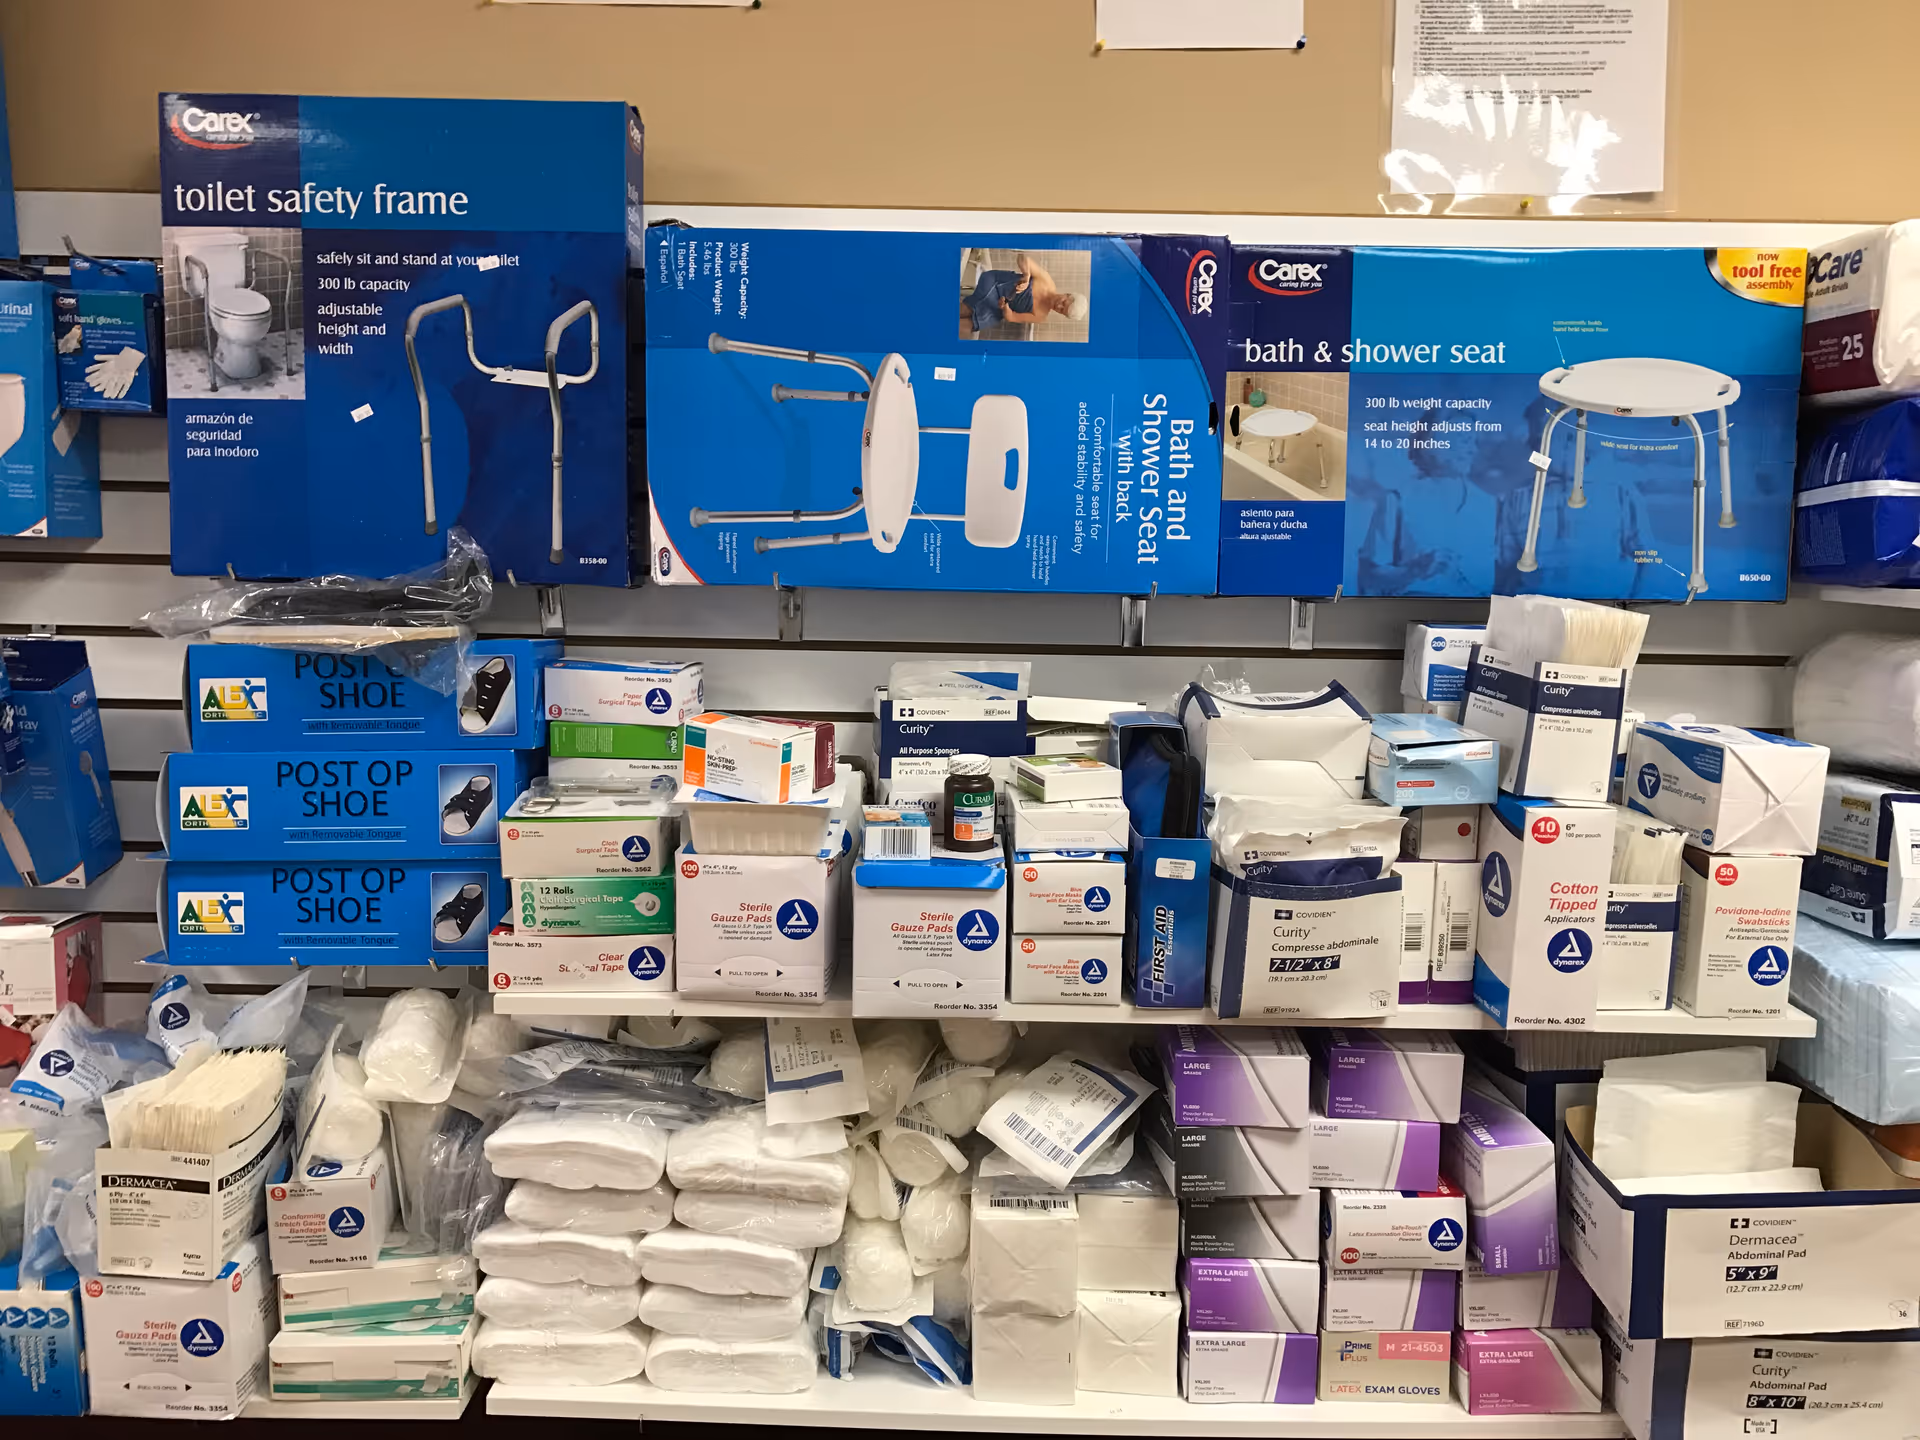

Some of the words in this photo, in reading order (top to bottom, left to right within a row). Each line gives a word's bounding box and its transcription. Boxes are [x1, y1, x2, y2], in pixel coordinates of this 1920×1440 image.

[182, 108, 254, 132] Carex
[175, 183, 256, 213] toilet
[268, 184, 363, 219] safety
[373, 184, 468, 215] frame
[730, 242, 738, 258] 300
[689, 241, 697, 280] Includes:
[715, 242, 723, 277] Product
[739, 242, 749, 275] Weight
[1757, 253, 1779, 261] now
[659, 249, 668, 283] Español
[730, 261, 738, 273] lbs
[1259, 259, 1322, 281] Carex
[1732, 265, 1765, 278] tool
[1769, 265, 1801, 278] free
[318, 278, 341, 290] 300
[345, 278, 356, 290] lb
[359, 278, 410, 292] capacity
[1197, 259, 1217, 314] Carex
[1300, 280, 1309, 288] for
[1746, 280, 1794, 291] assembly
[713, 279, 723, 315] Weight:
[738, 278, 749, 319] Capacity:
[318, 302, 383, 318] adjustable
[59, 315, 72, 323] soft
[74, 315, 93, 324] hand
[96, 315, 122, 325] gloves
[318, 322, 359, 337] height
[363, 322, 386, 336] and
[318, 342, 353, 356] width
[1245, 338, 1304, 363] bath
[1314, 340, 1332, 363] &
[1341, 339, 1441, 363] shower
[1449, 342, 1506, 363] seat
[1842, 334, 1863, 360] 25
[1365, 398, 1386, 408] 300
[1389, 397, 1399, 408] lb
[1402, 398, 1443, 410] weight
[1445, 398, 1491, 410] capacity
[186, 412, 236, 425] armazón
[238, 412, 253, 425] de
[1078, 402, 1089, 440] added
[1364, 422, 1387, 431] seat
[1391, 421, 1429, 433] height
[1431, 421, 1471, 433] adjusts
[1475, 421, 1501, 431] from
[186, 428, 241, 443] seguridad
[1141, 394, 1168, 497] Shower
[1169, 419, 1194, 478] Bath
[1364, 439, 1378, 449] 14
[1381, 440, 1392, 449] to
[1396, 438, 1410, 449] 20
[1413, 438, 1450, 449] inches
[186, 446, 211, 458] para
[214, 445, 259, 458] inodoro
[1092, 417, 1105, 492] Comfortable
[1118, 435, 1134, 473] with
[1074, 444, 1088, 490] stability
[1075, 494, 1086, 516] and
[1091, 496, 1101, 520] seat
[1116, 481, 1133, 523] back
[1167, 489, 1190, 540] and
[1241, 508, 1273, 517] asiento
[1275, 510, 1294, 518] para
[1241, 520, 1271, 529] bañera
[1273, 522, 1278, 530] y
[1280, 520, 1307, 529] ducha
[1071, 520, 1085, 554] safety
[1091, 524, 1102, 540] for
[1138, 507, 1162, 564] Seat
[580, 557, 607, 565] B358-00
[1740, 574, 1771, 582] B650-00
[320, 682, 405, 709] SHOE
[1544, 685, 1571, 696] Curity
[1541, 705, 1572, 714] Compresses
[1573, 708, 1601, 716] universelles
[899, 724, 930, 735] Curity
[909, 747, 932, 755] Purpose
[933, 747, 959, 755] Sponges
[277, 761, 359, 787] POST
[367, 761, 413, 786] OP
[302, 791, 388, 817] SHOE
[963, 793, 990, 805] CURAD
[1538, 822, 1556, 832] 10
[1720, 868, 1733, 876] 50
[272, 868, 353, 894] POST
[361, 868, 405, 893] OP
[1550, 882, 1598, 894] Cotton
[297, 898, 381, 923] SHOE
[739, 902, 772, 912] Sterile
[1549, 898, 1597, 912] Tipped
[1715, 906, 1791, 916] Povidone-Iodine
[711, 913, 744, 924] Gauze
[747, 913, 772, 924] Pads
[1155, 906, 1167, 934] AID
[1544, 915, 1595, 923] Applicators
[1737, 917, 1790, 926] Swabsticks
[783, 926, 812, 934] dynarex
[1167, 910, 1175, 955] Essentials
[1273, 926, 1311, 939] Curity
[1272, 942, 1325, 953] Compresse
[1327, 936, 1379, 950] abdominale
[1153, 937, 1166, 982] FIRST
[1553, 958, 1584, 966] dynarex
[1338, 1056, 1366, 1064] LARGE
[183, 1158, 210, 1166] 441407
[108, 1176, 174, 1190] DERMACEA
[1753, 1219, 1792, 1227] COVIDIEN
[1729, 1234, 1797, 1245] Dermacea
[1728, 1250, 1785, 1259] Abdominal
[1787, 1249, 1806, 1258] Pad
[1198, 1269, 1221, 1277] EXTRA
[1222, 1269, 1248, 1277] LARGE
[1728, 1268, 1743, 1280] 5"
[1747, 1270, 1755, 1279] x
[1759, 1266, 1775, 1279] 9"
[1345, 1341, 1372, 1350] PRIME
[1401, 1344, 1443, 1352] 21-4503
[1344, 1353, 1368, 1362] PLUS
[1752, 1365, 1791, 1378] Curity
[1330, 1385, 1361, 1393] LATEX
[1365, 1385, 1395, 1394] EXAM
[1398, 1386, 1441, 1395] GLOVES
[1750, 1381, 1805, 1390] Abdominal
[1808, 1382, 1827, 1390] Pad
